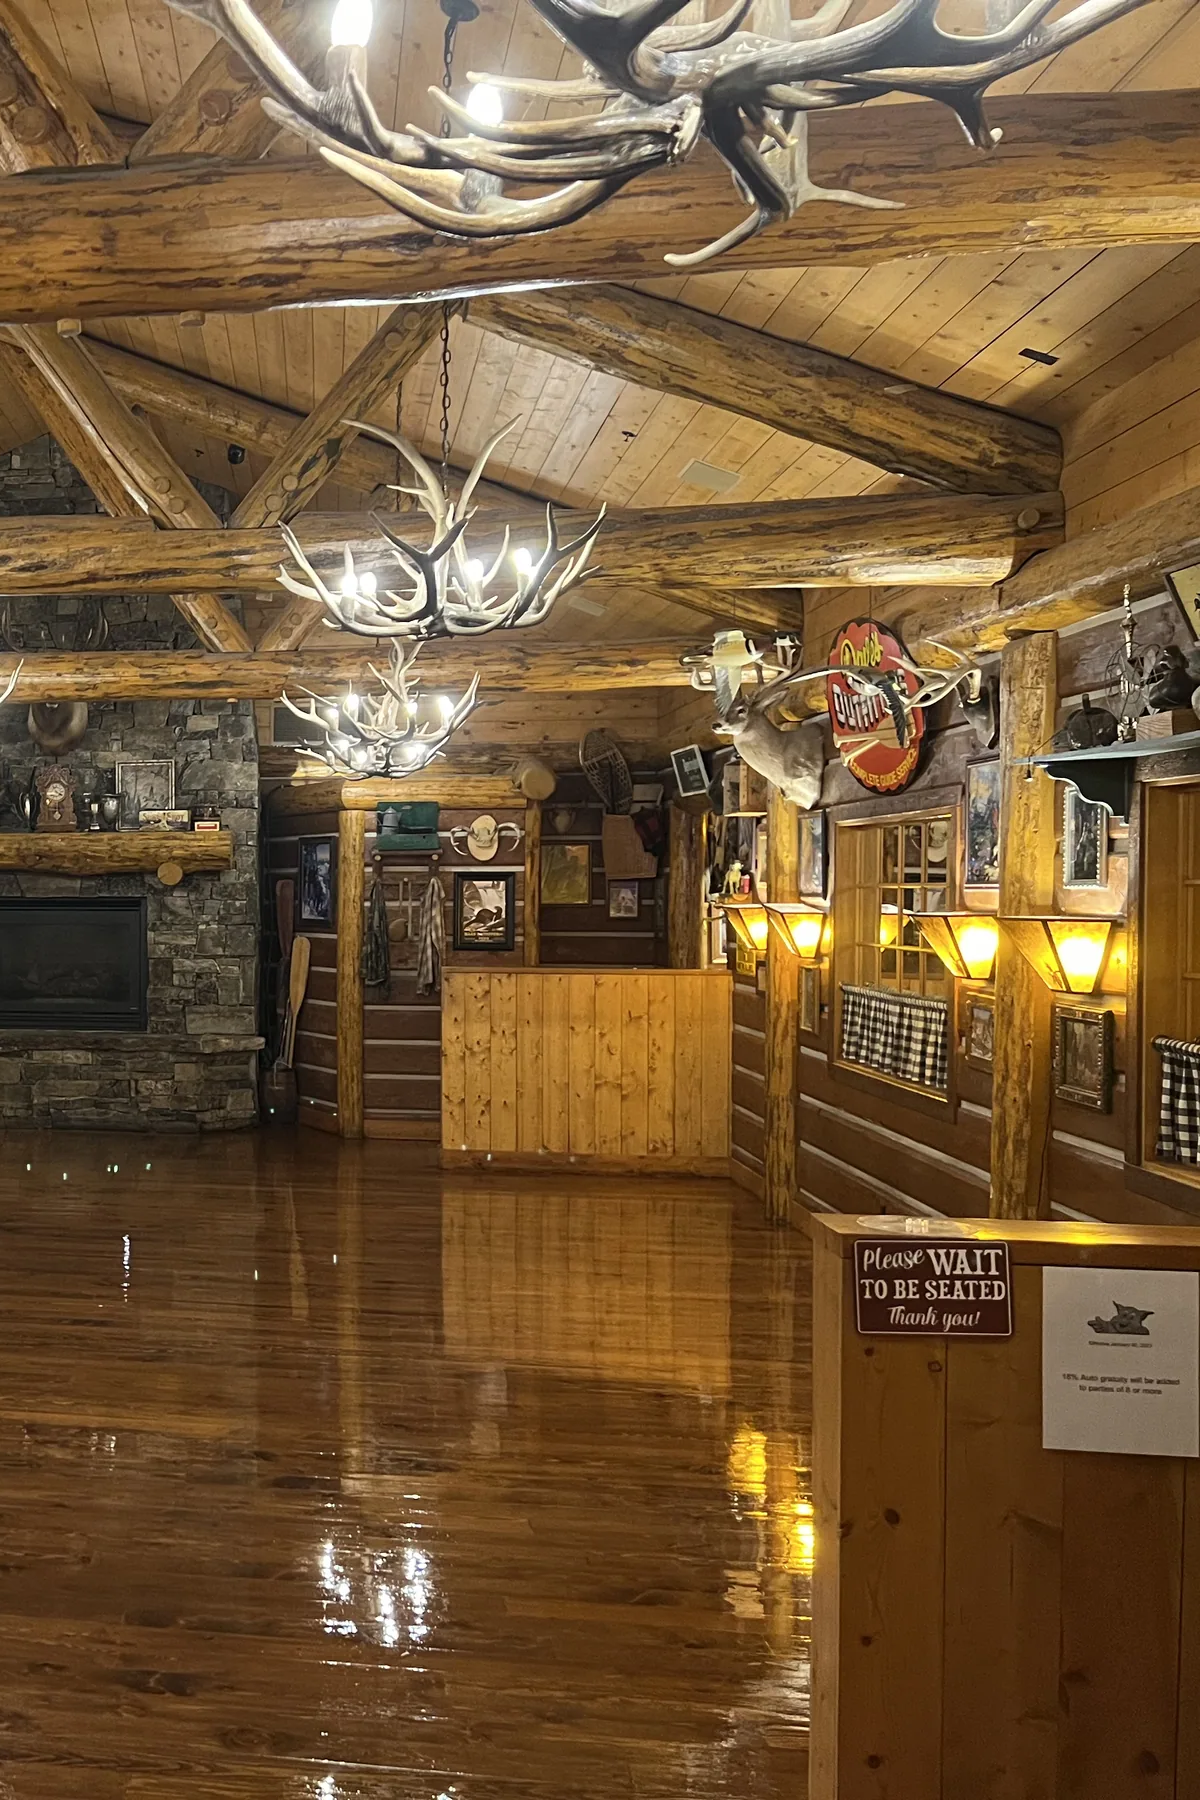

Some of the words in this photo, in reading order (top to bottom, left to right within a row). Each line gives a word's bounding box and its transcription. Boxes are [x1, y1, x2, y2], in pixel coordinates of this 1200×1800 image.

[863, 1247, 925, 1272] Please
[926, 1249, 1003, 1276] WAIT
[860, 1279, 888, 1300] TO
[893, 1279, 920, 1299] BE
[924, 1279, 1006, 1301] SEATED
[887, 1305, 939, 1326] Thank
[942, 1311, 981, 1333] you!
[1088, 1385, 1114, 1393] parties
[1100, 1376, 1128, 1384] gratuity
